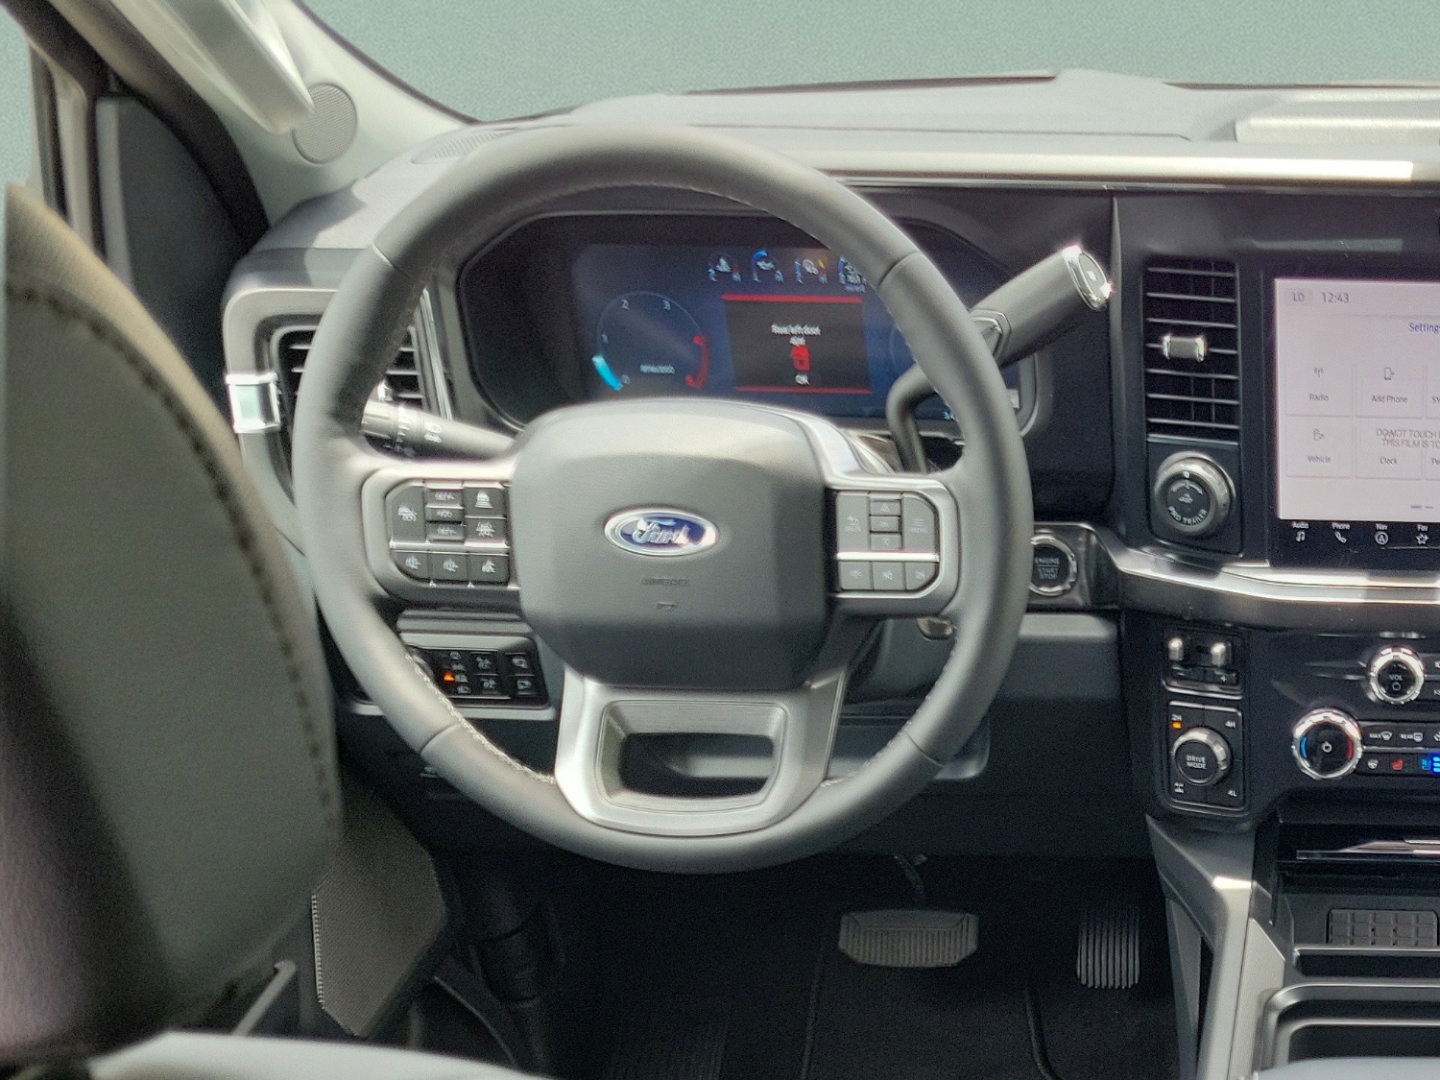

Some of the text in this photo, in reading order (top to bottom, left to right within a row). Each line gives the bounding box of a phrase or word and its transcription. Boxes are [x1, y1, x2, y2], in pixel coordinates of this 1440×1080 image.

[1321, 292, 1350, 303] 12:43
[1371, 394, 1409, 404] Add Phone
[1408, 430, 1437, 439] TOUCH
[1379, 456, 1398, 465] Clock
[1167, 506, 1208, 526] PRO TRAILER
[631, 517, 691, 546] Ford
[1388, 674, 1403, 682] VOL
[1186, 755, 1206, 763] DRIVE
